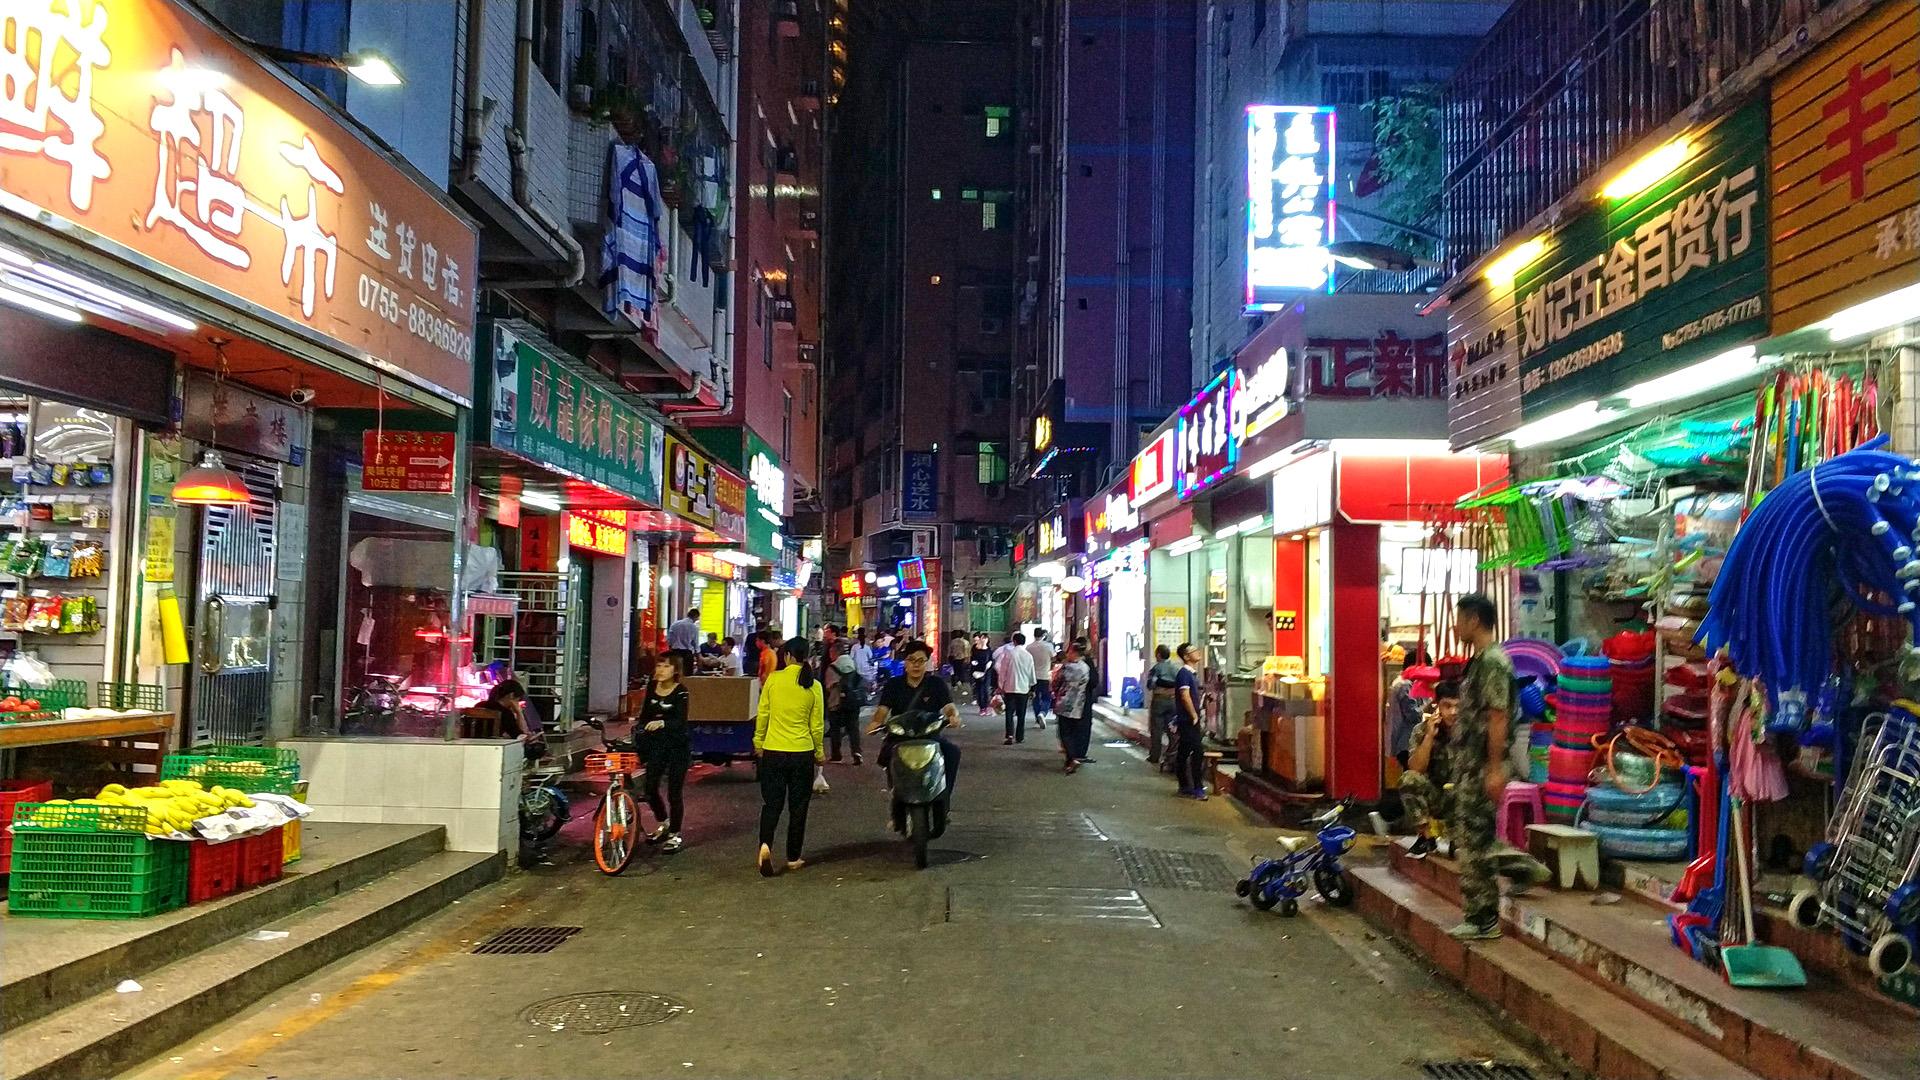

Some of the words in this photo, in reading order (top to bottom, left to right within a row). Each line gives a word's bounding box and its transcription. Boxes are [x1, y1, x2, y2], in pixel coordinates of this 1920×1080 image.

[358, 273, 472, 361] 0755-88366929
[1521, 166, 1757, 356] 刘记五金百货行
